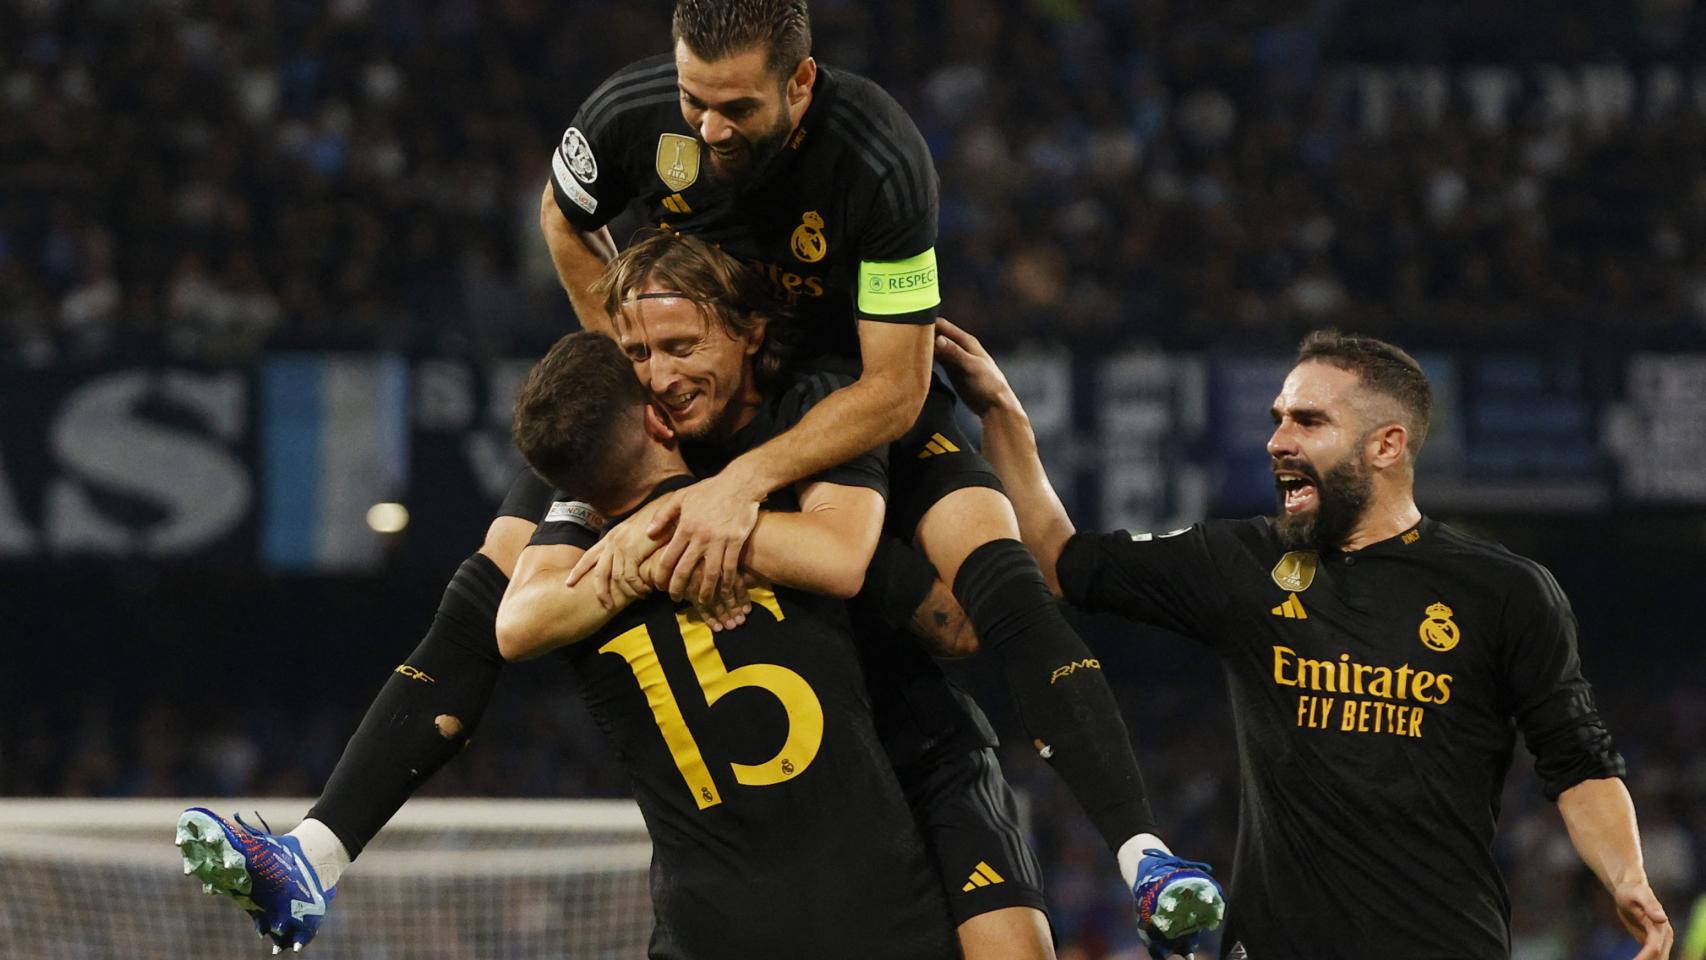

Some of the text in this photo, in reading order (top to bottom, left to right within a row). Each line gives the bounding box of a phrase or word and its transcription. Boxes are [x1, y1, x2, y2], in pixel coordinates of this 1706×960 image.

[667, 169, 686, 180] FIFA
[598, 587, 825, 810] 15
[1272, 645, 1453, 705] Emirates
[1297, 695, 1425, 738] FLY BETTER
